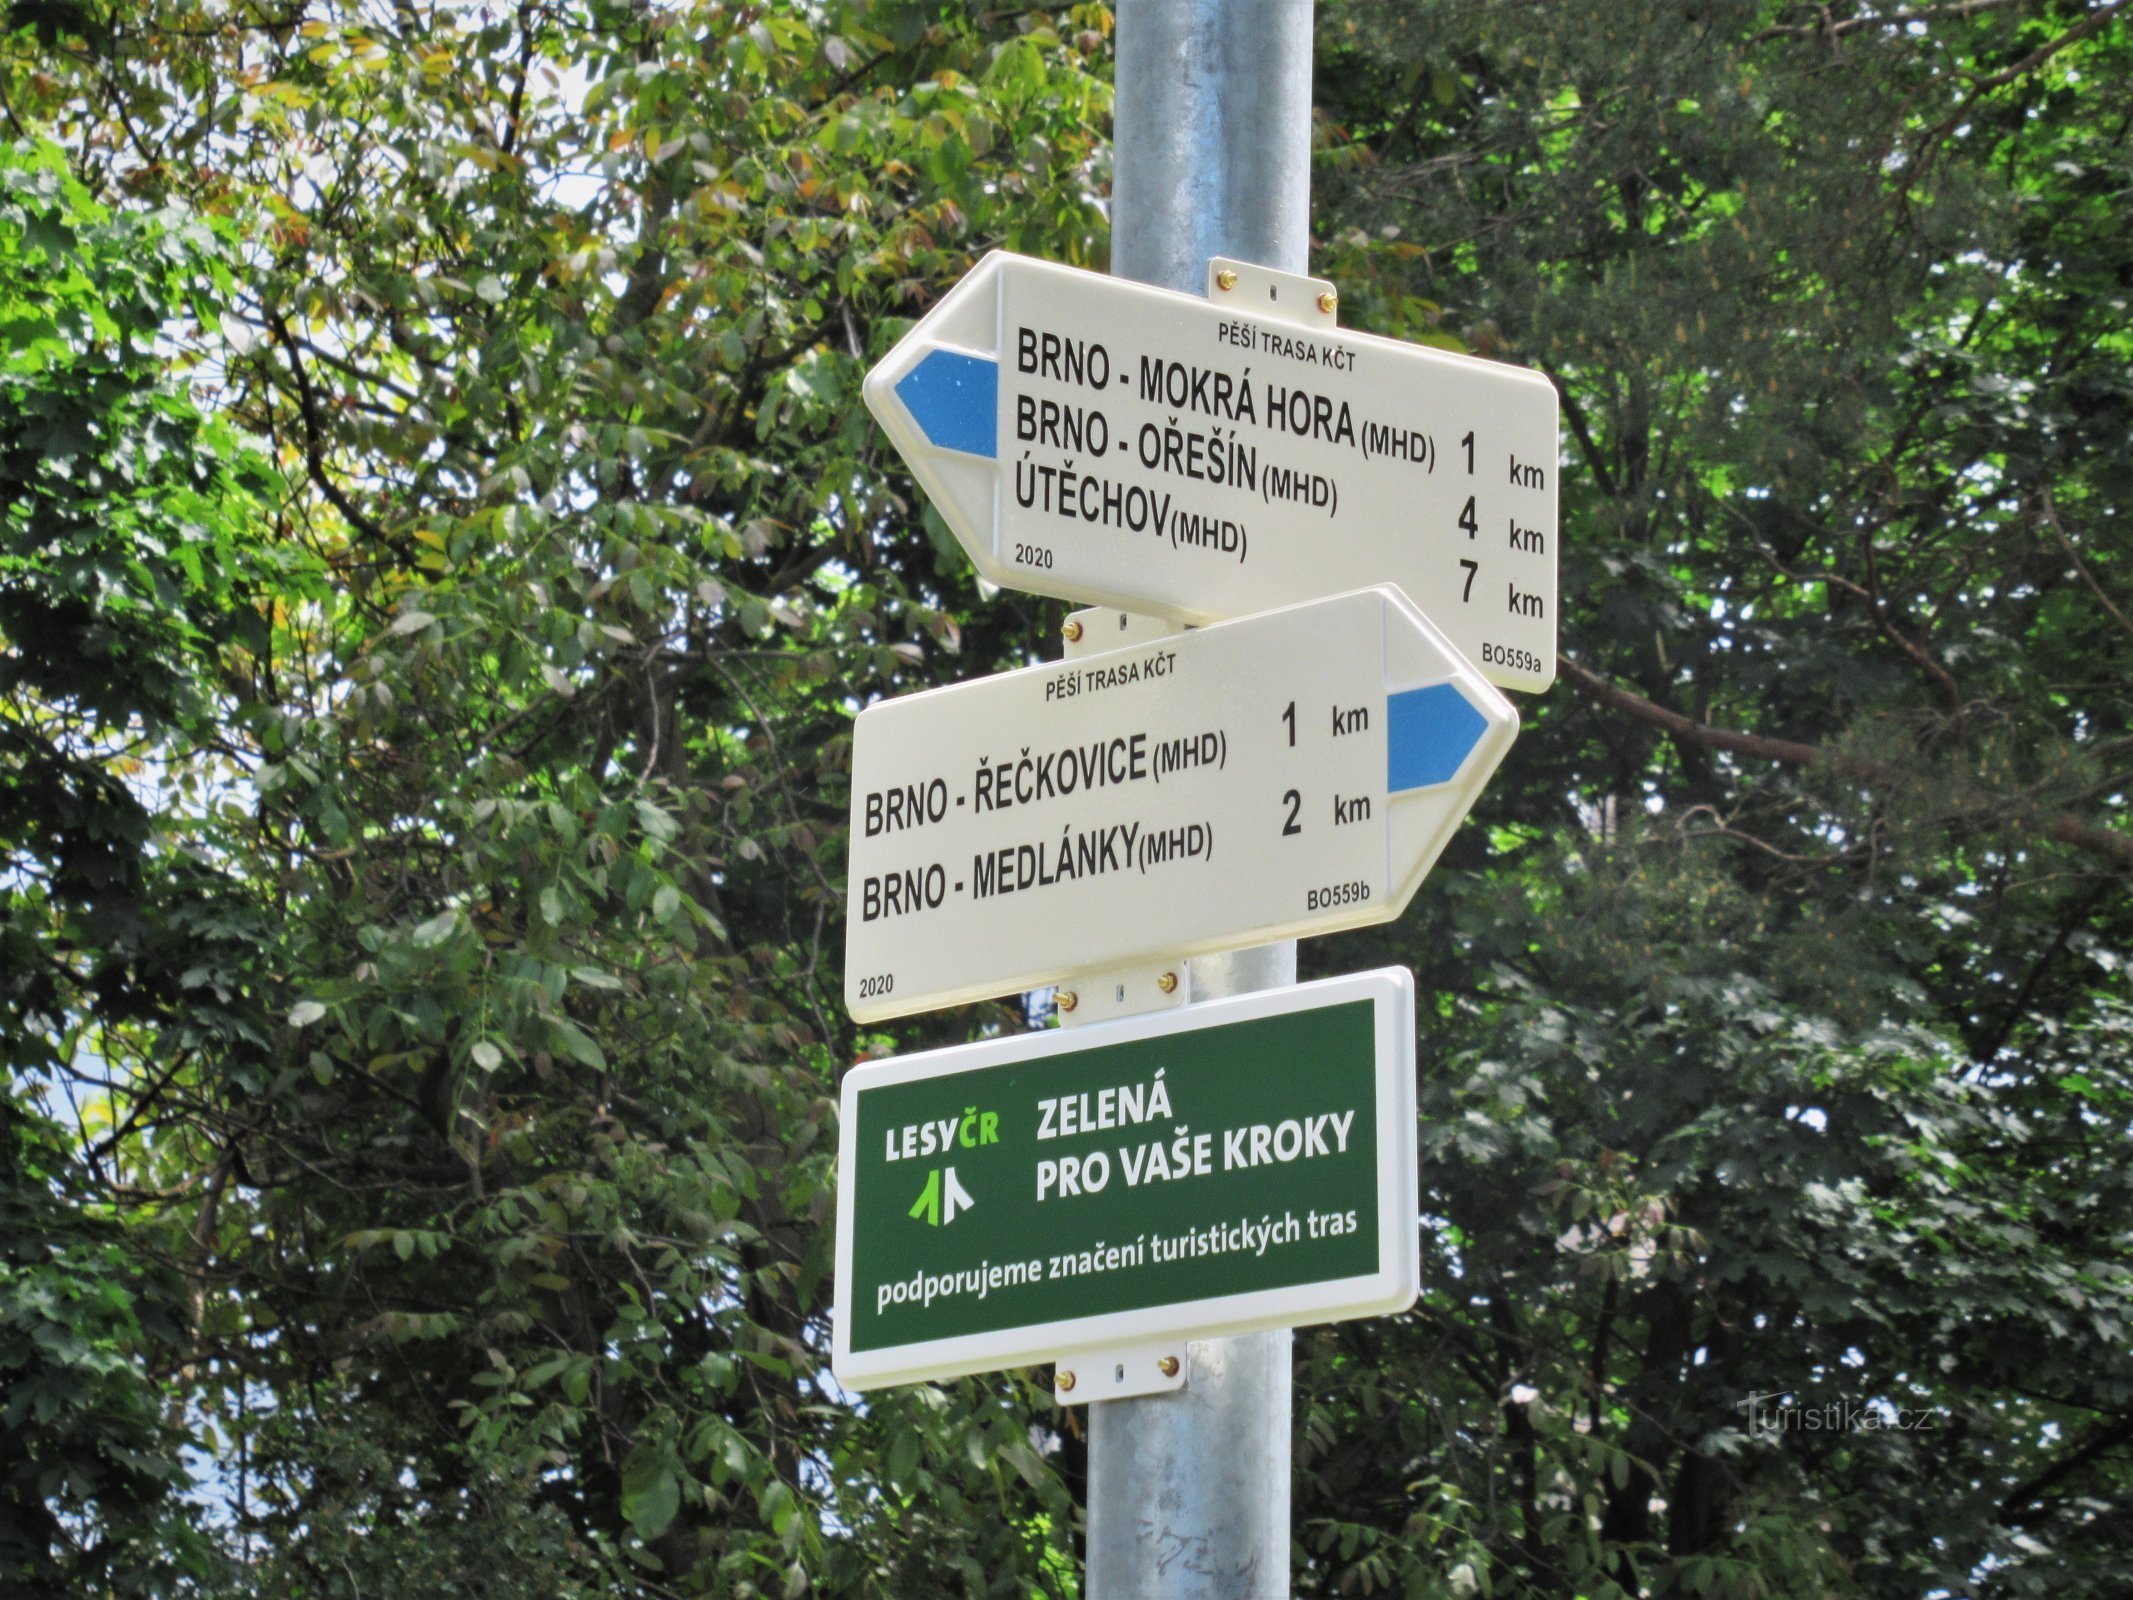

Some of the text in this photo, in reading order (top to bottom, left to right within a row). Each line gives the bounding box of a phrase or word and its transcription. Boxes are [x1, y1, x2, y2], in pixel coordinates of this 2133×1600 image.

[1218, 320, 1356, 372] PĚŠÍ TRASA KČT
[1018, 326, 1110, 391] BRNO
[1140, 354, 1257, 427] MOKRÁ
[1267, 384, 1356, 448] HORA
[1361, 420, 1435, 474] (MHD)
[1461, 430, 1475, 475] 1
[1509, 454, 1545, 491] km
[1016, 393, 1109, 460] BRNO
[1138, 416, 1256, 492] OŘEŠÍN
[1262, 464, 1338, 518] (MHD)
[1458, 495, 1479, 540] 4
[1509, 518, 1544, 555] km
[1015, 543, 1053, 569] 2020
[1459, 558, 1479, 603] 7
[1508, 582, 1544, 619] km
[1046, 651, 1176, 702] PĚŠÍ TRASA KČT
[1482, 642, 1541, 673] BO559a
[865, 777, 948, 838] BRNO
[975, 732, 1147, 814] ŘEČKOVICE
[1152, 729, 1227, 784] (MHD)
[1282, 700, 1296, 747] 1
[1332, 705, 1369, 737] km
[862, 863, 946, 922] BRNO
[1282, 788, 1302, 837] 2
[1334, 794, 1371, 826] km
[1307, 880, 1370, 911] BO559b
[859, 973, 894, 998] 2020
[1036, 1066, 1173, 1141] ZELENÁ
[1036, 1109, 1355, 1202] PRO VAŠE KROKY
[877, 1209, 1357, 1316] podporujeme značení turistických tras
